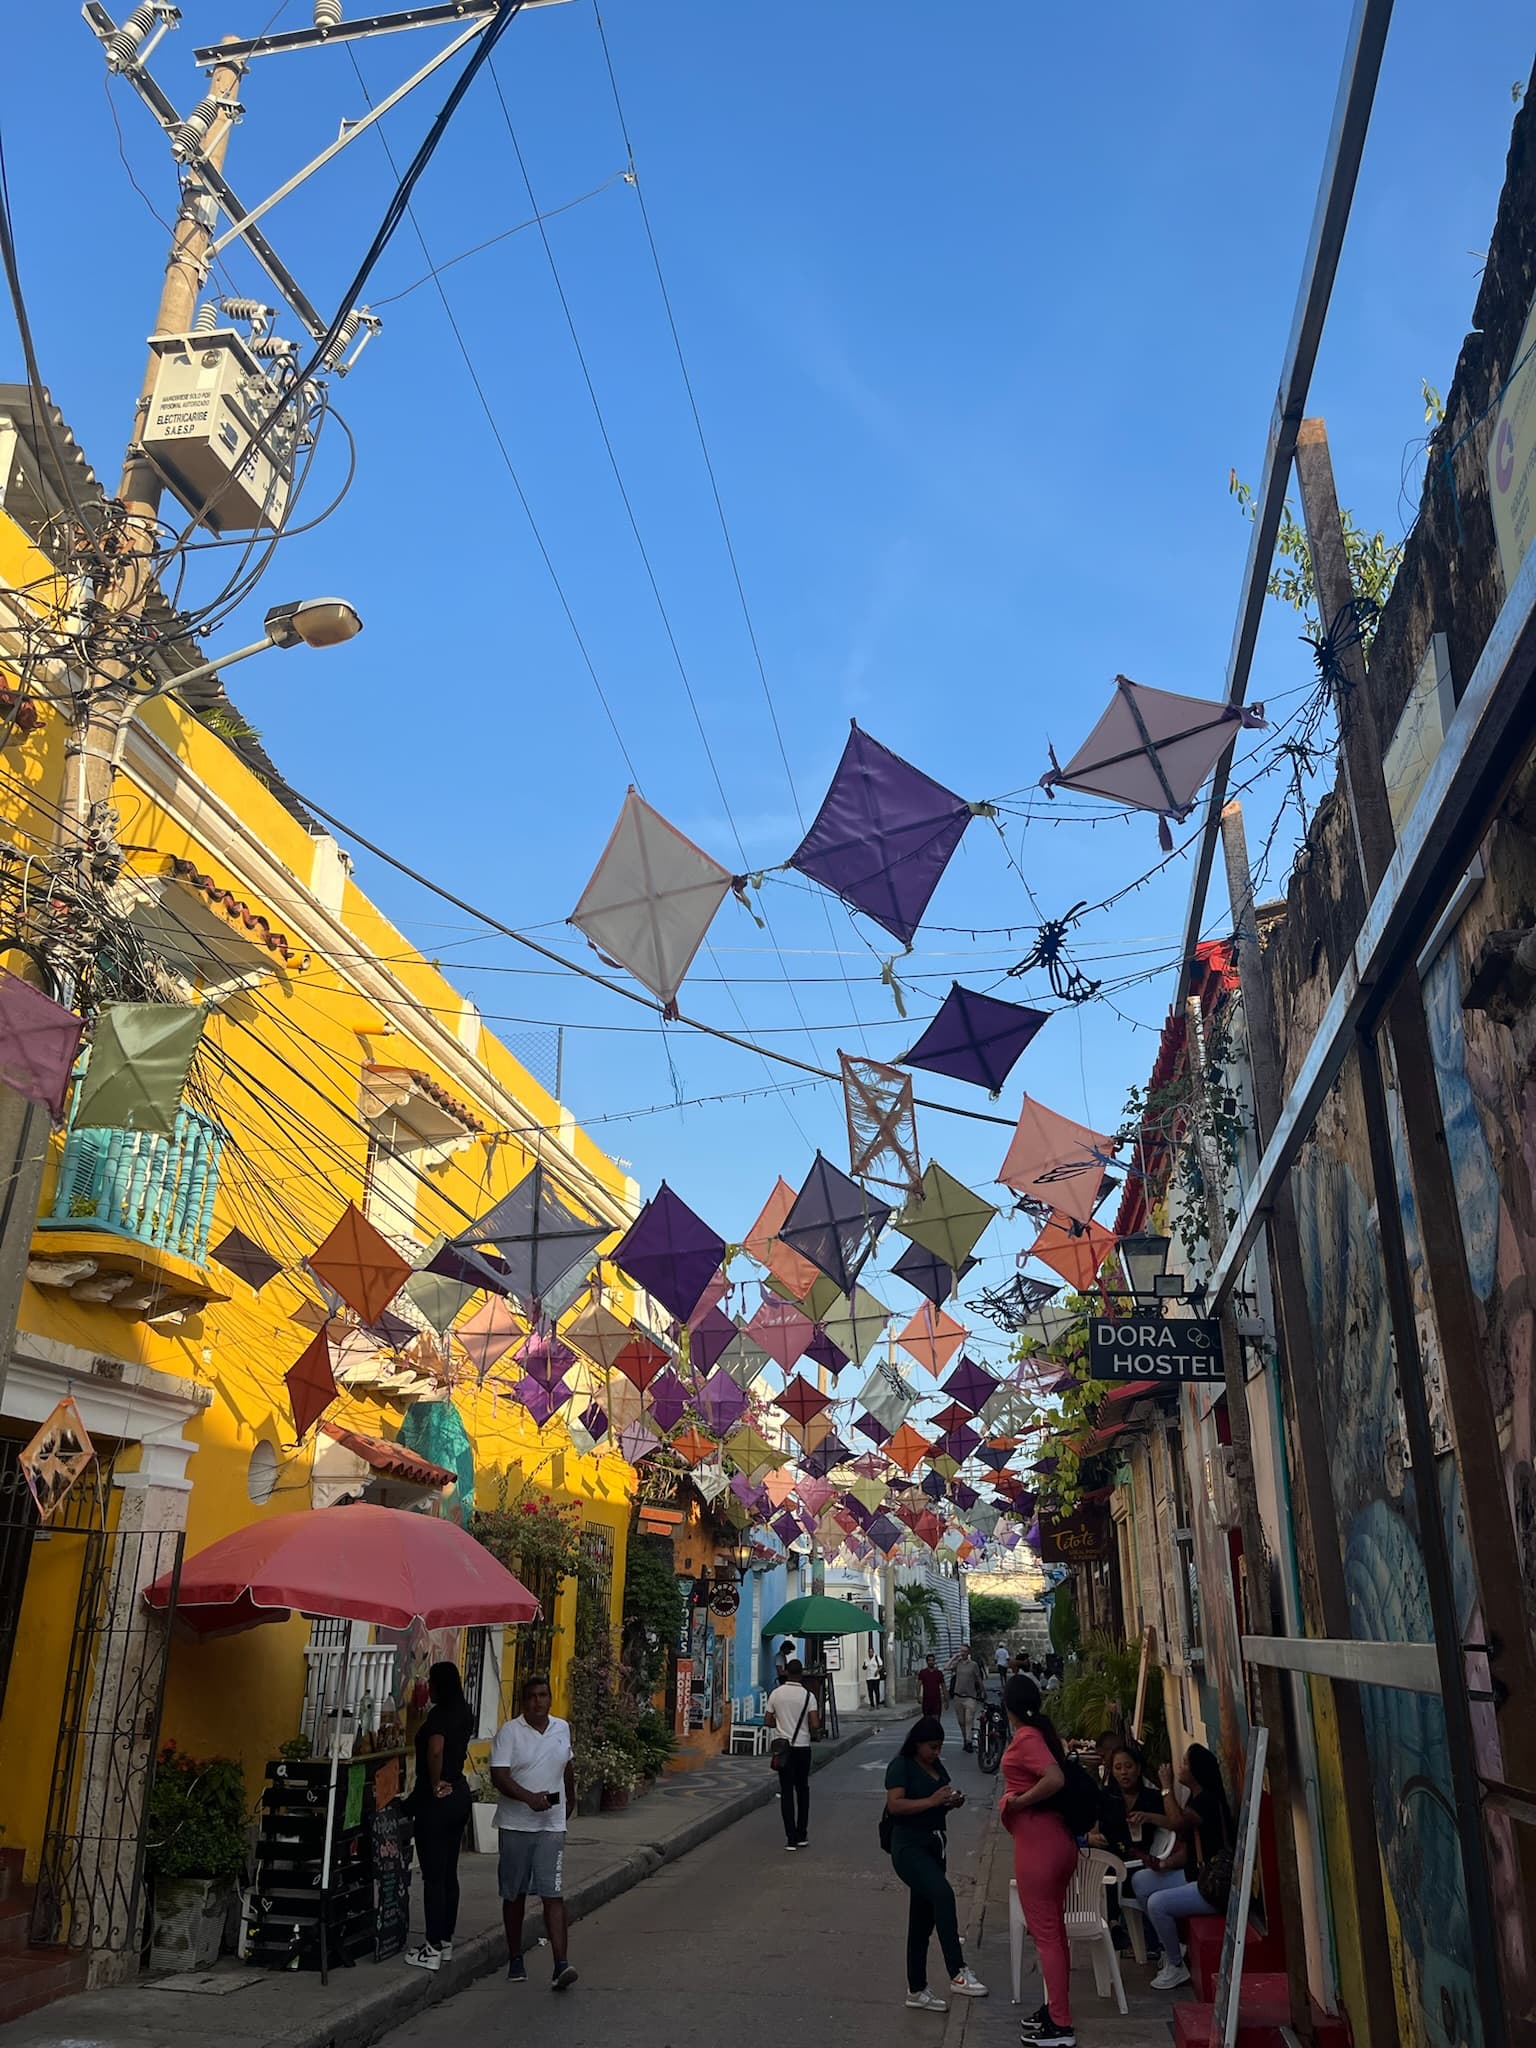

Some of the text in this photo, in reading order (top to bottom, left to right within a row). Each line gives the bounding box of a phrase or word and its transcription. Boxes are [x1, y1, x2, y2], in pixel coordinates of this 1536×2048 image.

[157, 411, 208, 425] ELECTRICARIBE
[1097, 1325, 1177, 1348] DORA
[1113, 1353, 1226, 1376] HOSTEL
[711, 1583, 737, 1595] MONEY
[710, 1602, 738, 1617] EXCHANGE
[680, 1596, 690, 1653] TOURS
[684, 1672, 692, 1737] EXCHANGE
